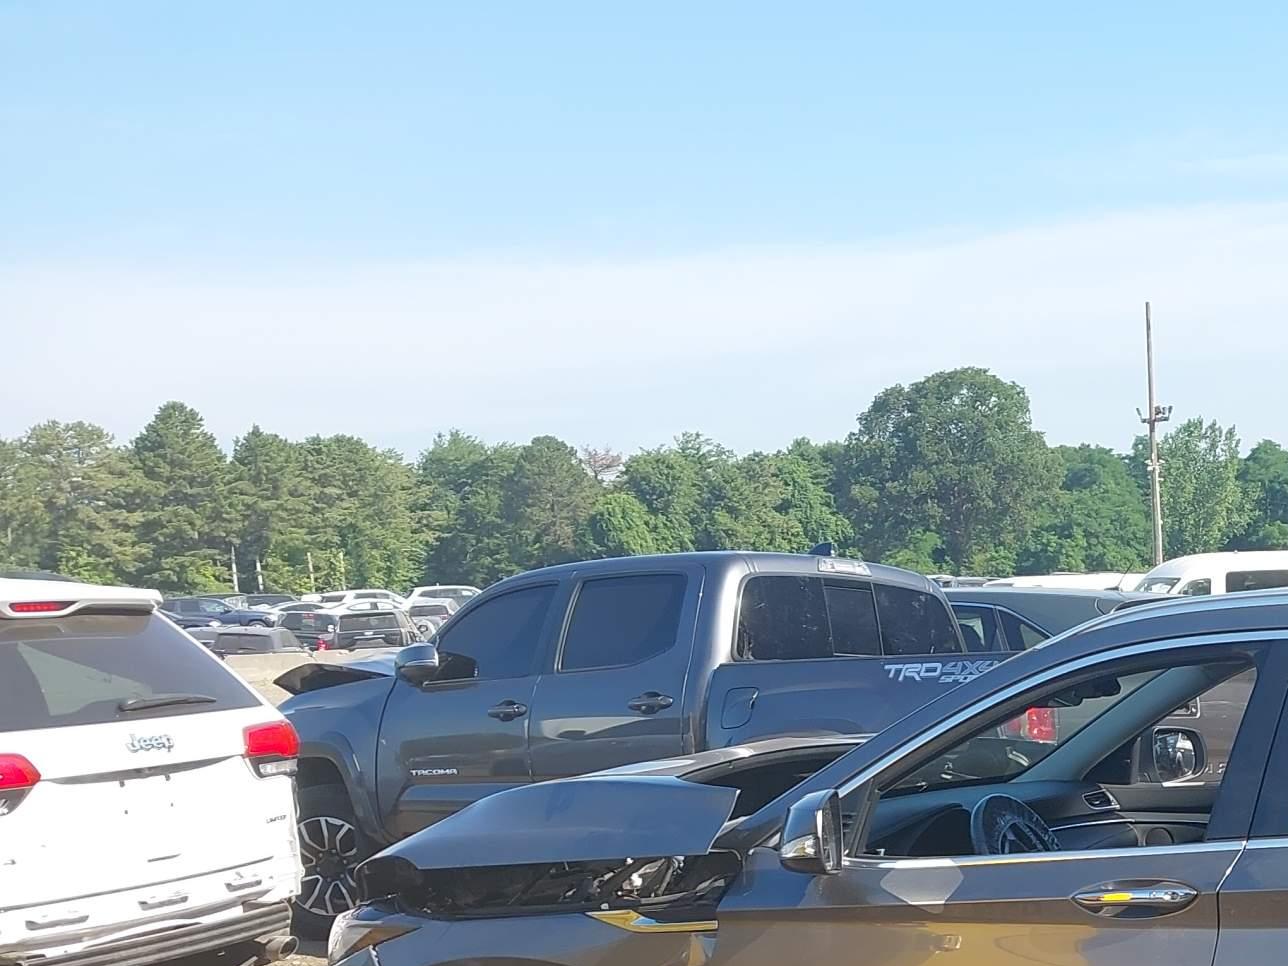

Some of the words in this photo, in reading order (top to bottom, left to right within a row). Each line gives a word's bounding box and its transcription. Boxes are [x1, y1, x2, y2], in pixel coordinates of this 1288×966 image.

[884, 662, 942, 681] TRD
[125, 733, 174, 753] Jeep
[409, 767, 458, 777] TACOMA
